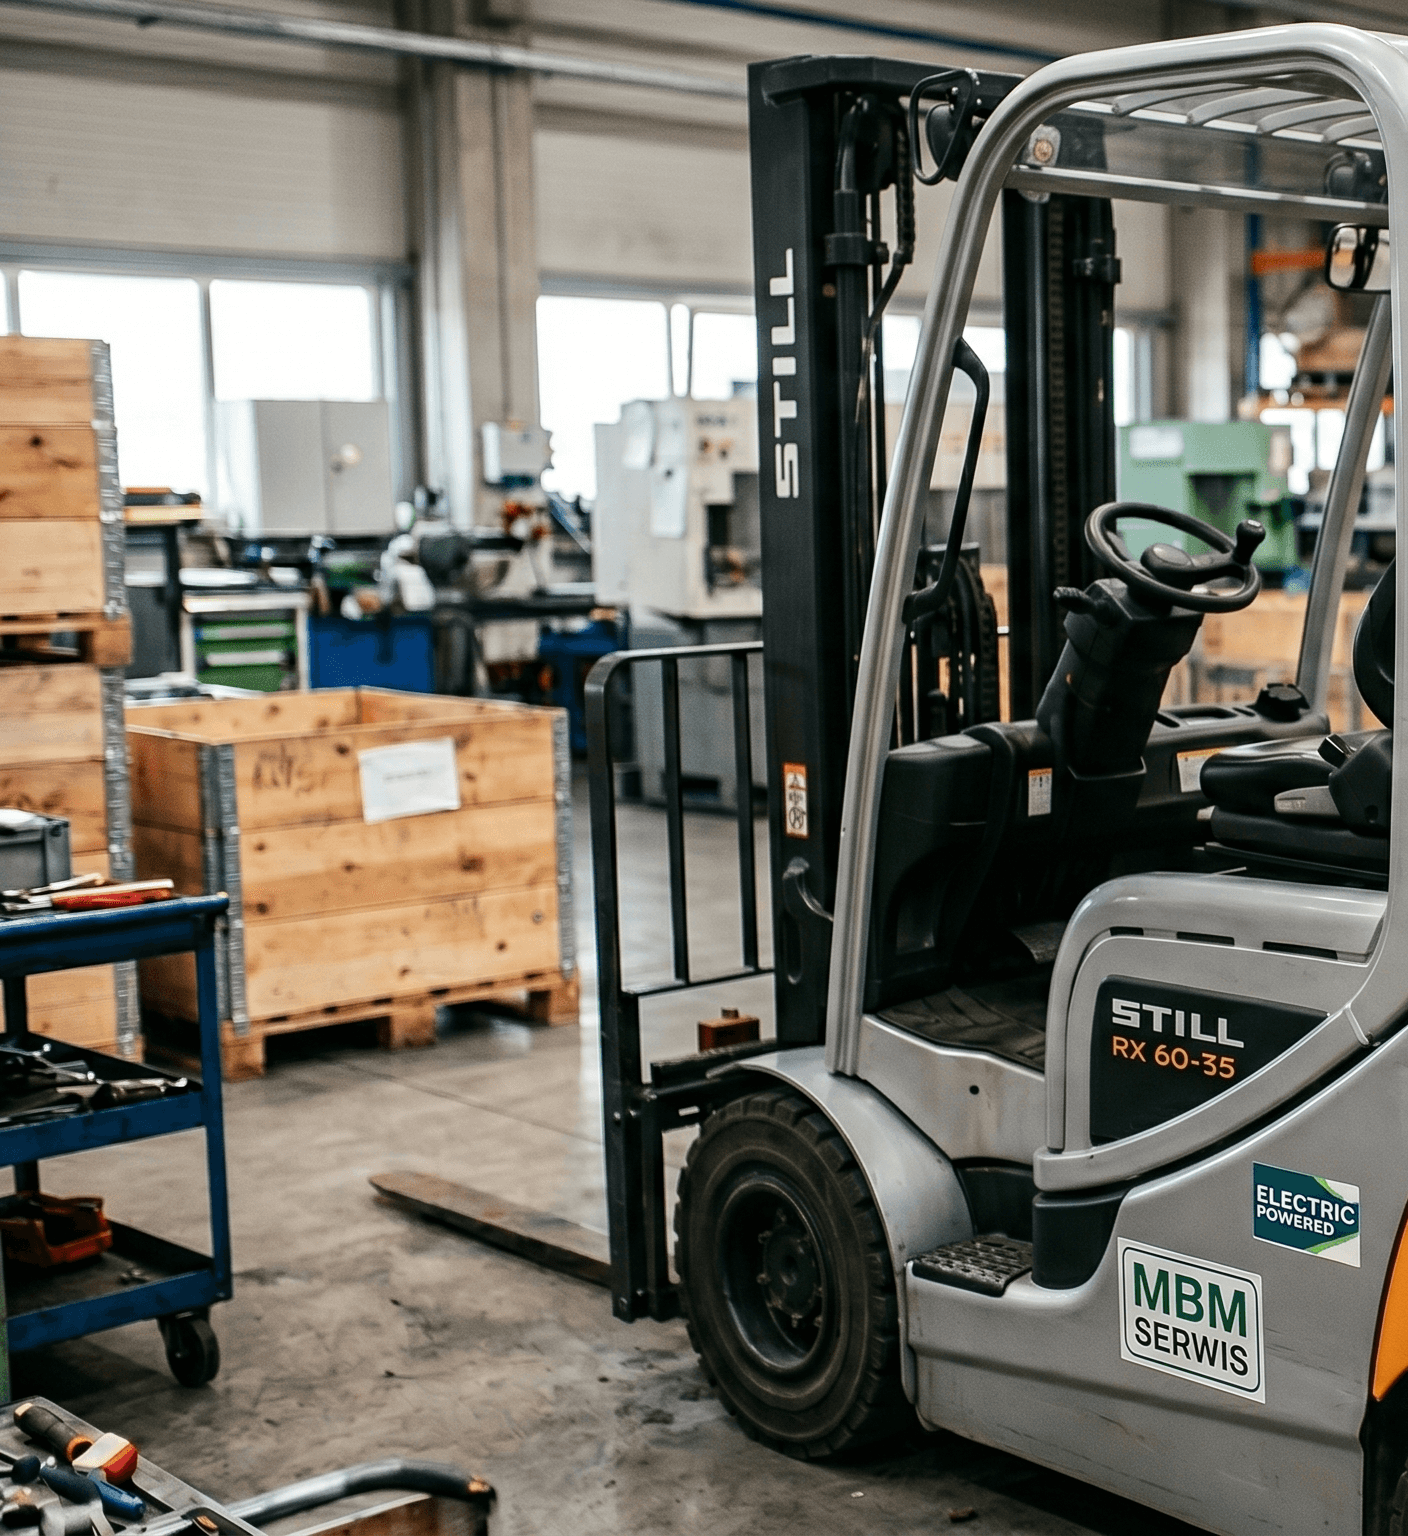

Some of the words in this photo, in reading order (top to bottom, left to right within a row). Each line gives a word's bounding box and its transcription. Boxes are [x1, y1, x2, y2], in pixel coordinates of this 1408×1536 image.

[769, 247, 799, 499] STILL
[1112, 997, 1245, 1049] STILL
[1112, 1035, 1147, 1063] RX
[1154, 1044, 1236, 1079] 60-35
[1256, 1184, 1356, 1225] ELECTRIC
[1256, 1204, 1335, 1236] POWERED
[1133, 1261, 1247, 1338] MBM
[1135, 1316, 1249, 1376] SERWIS
